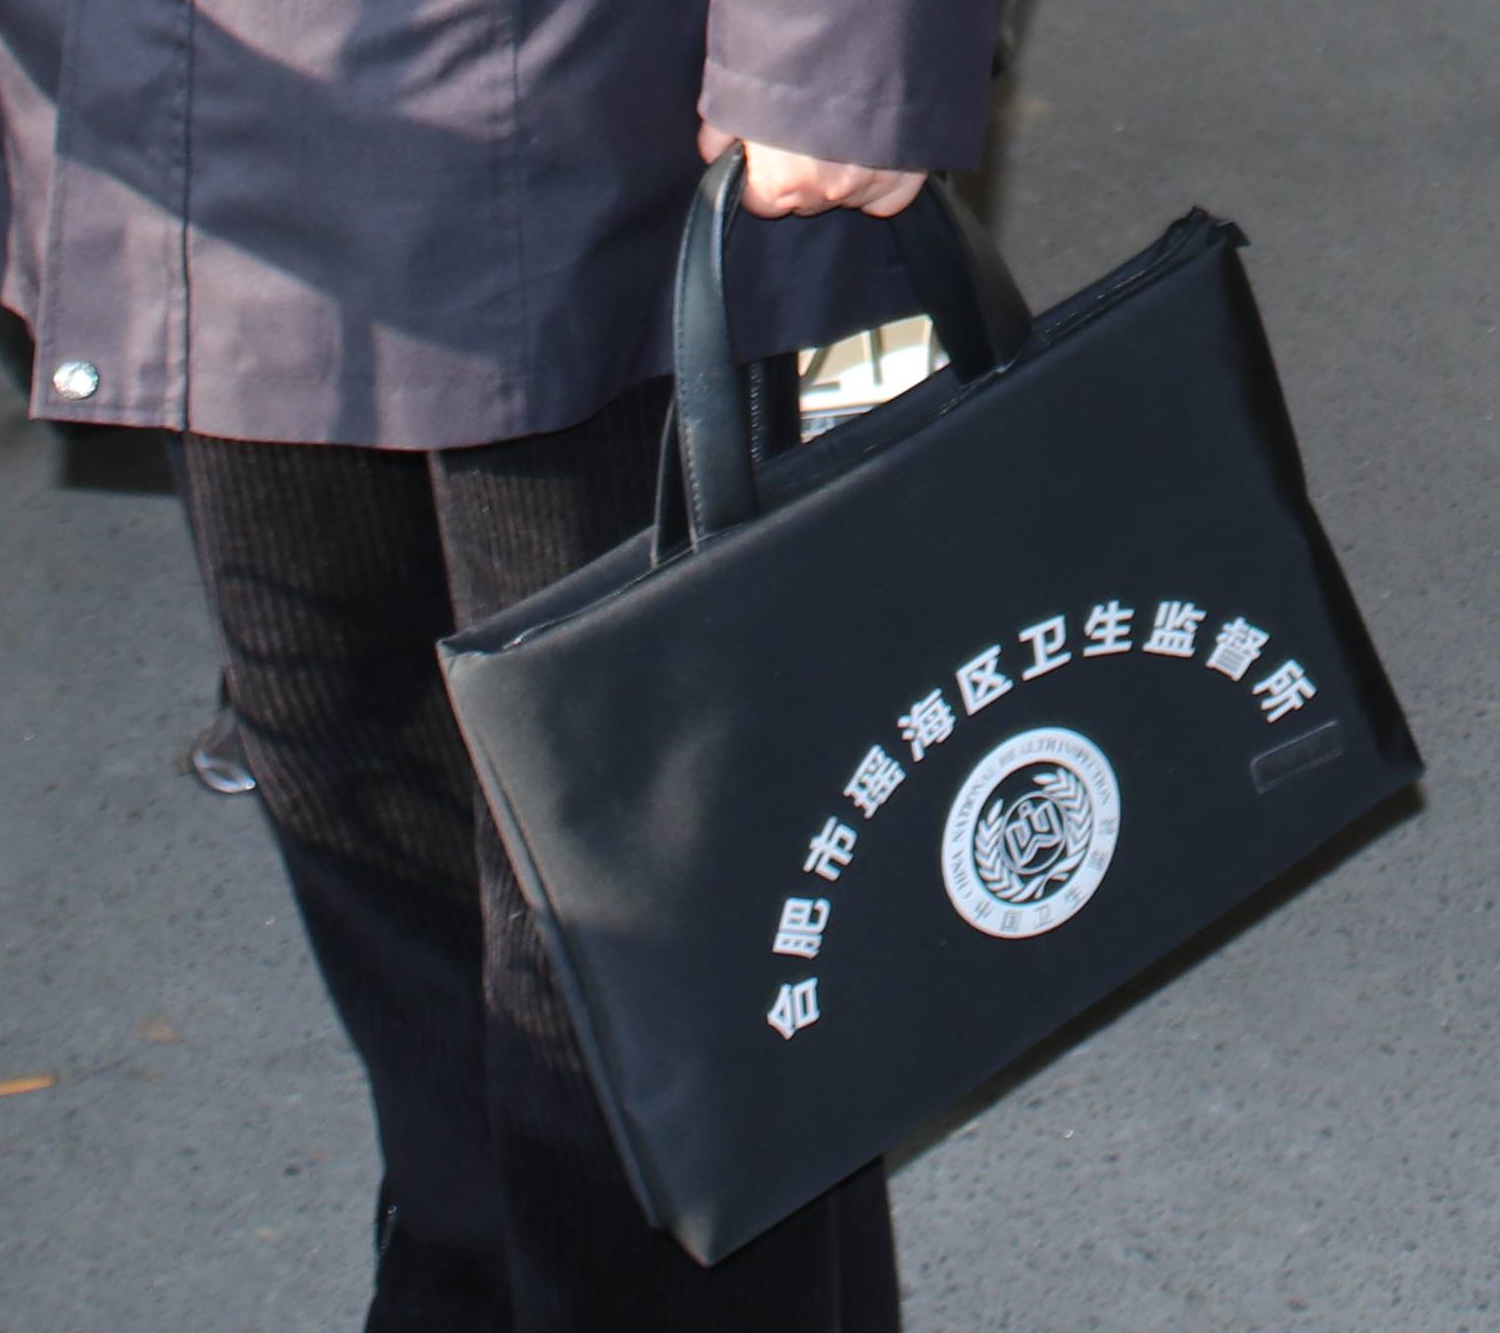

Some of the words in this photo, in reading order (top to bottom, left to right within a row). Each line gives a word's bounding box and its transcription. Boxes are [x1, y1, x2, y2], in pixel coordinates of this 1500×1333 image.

[768, 600, 1316, 1039] 合肥市瑶海区卫生监督所
